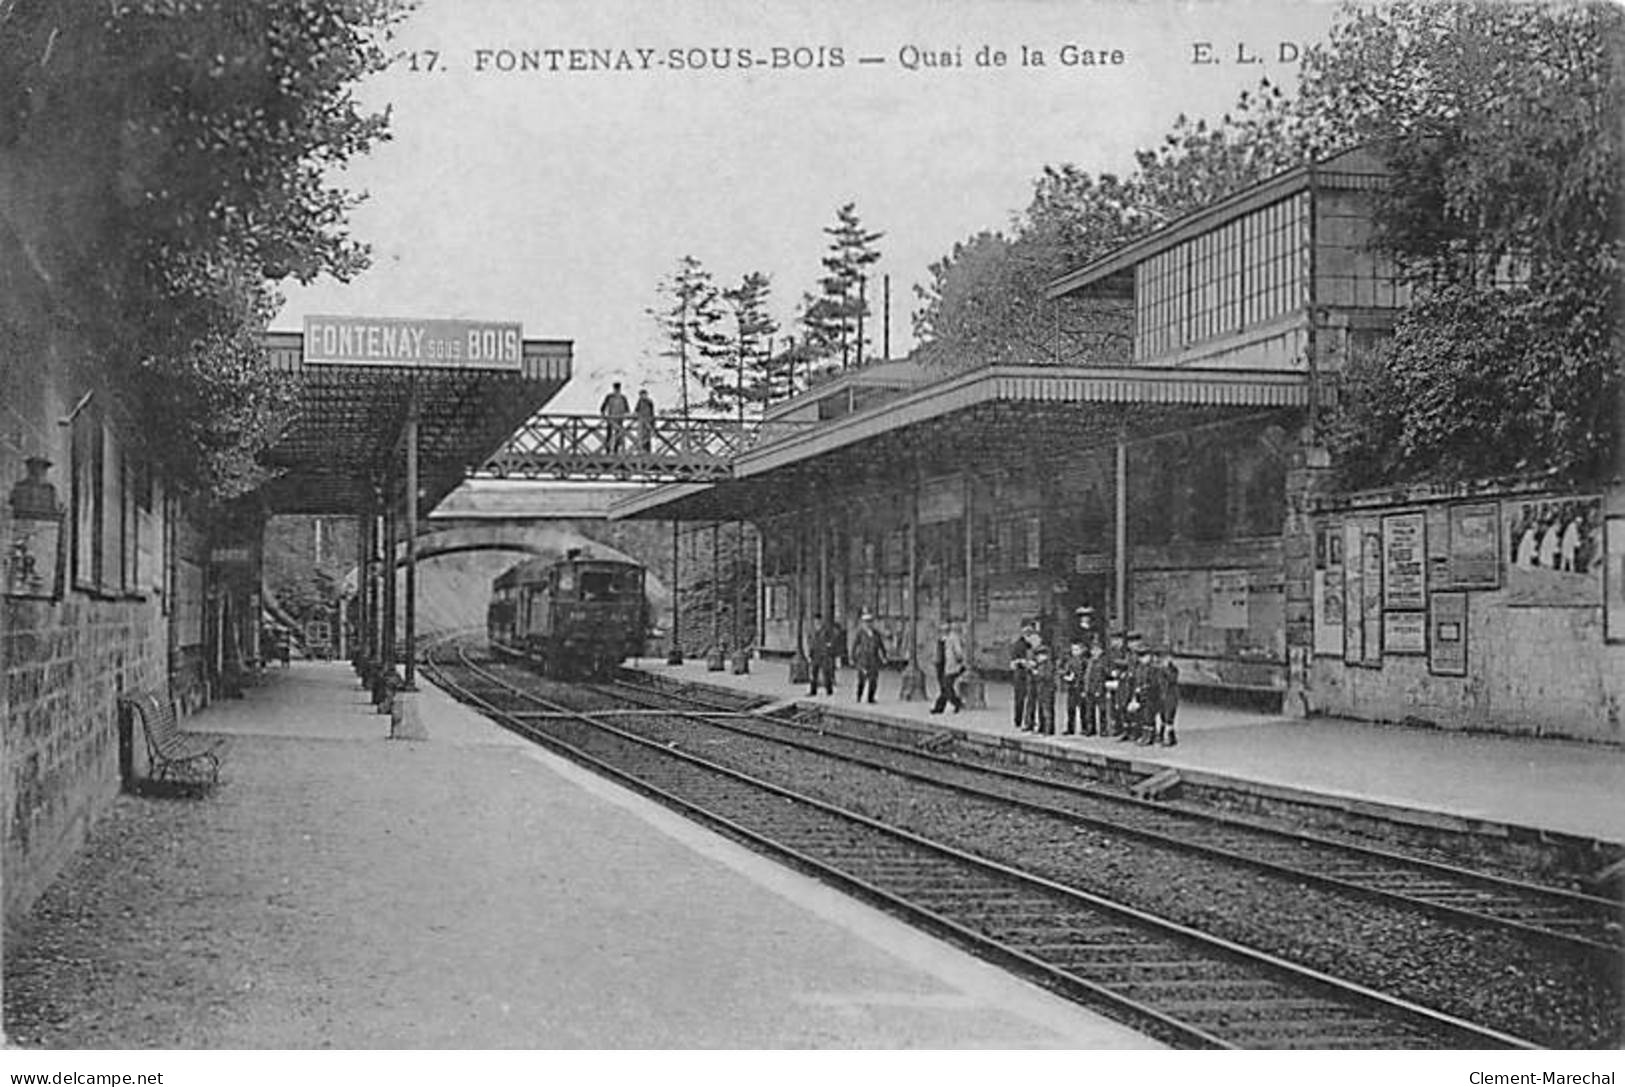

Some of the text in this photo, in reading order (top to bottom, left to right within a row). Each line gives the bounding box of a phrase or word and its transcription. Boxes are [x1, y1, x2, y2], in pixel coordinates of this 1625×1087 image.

[310, 324, 517, 361] FONTENAY SOUS BOIS
